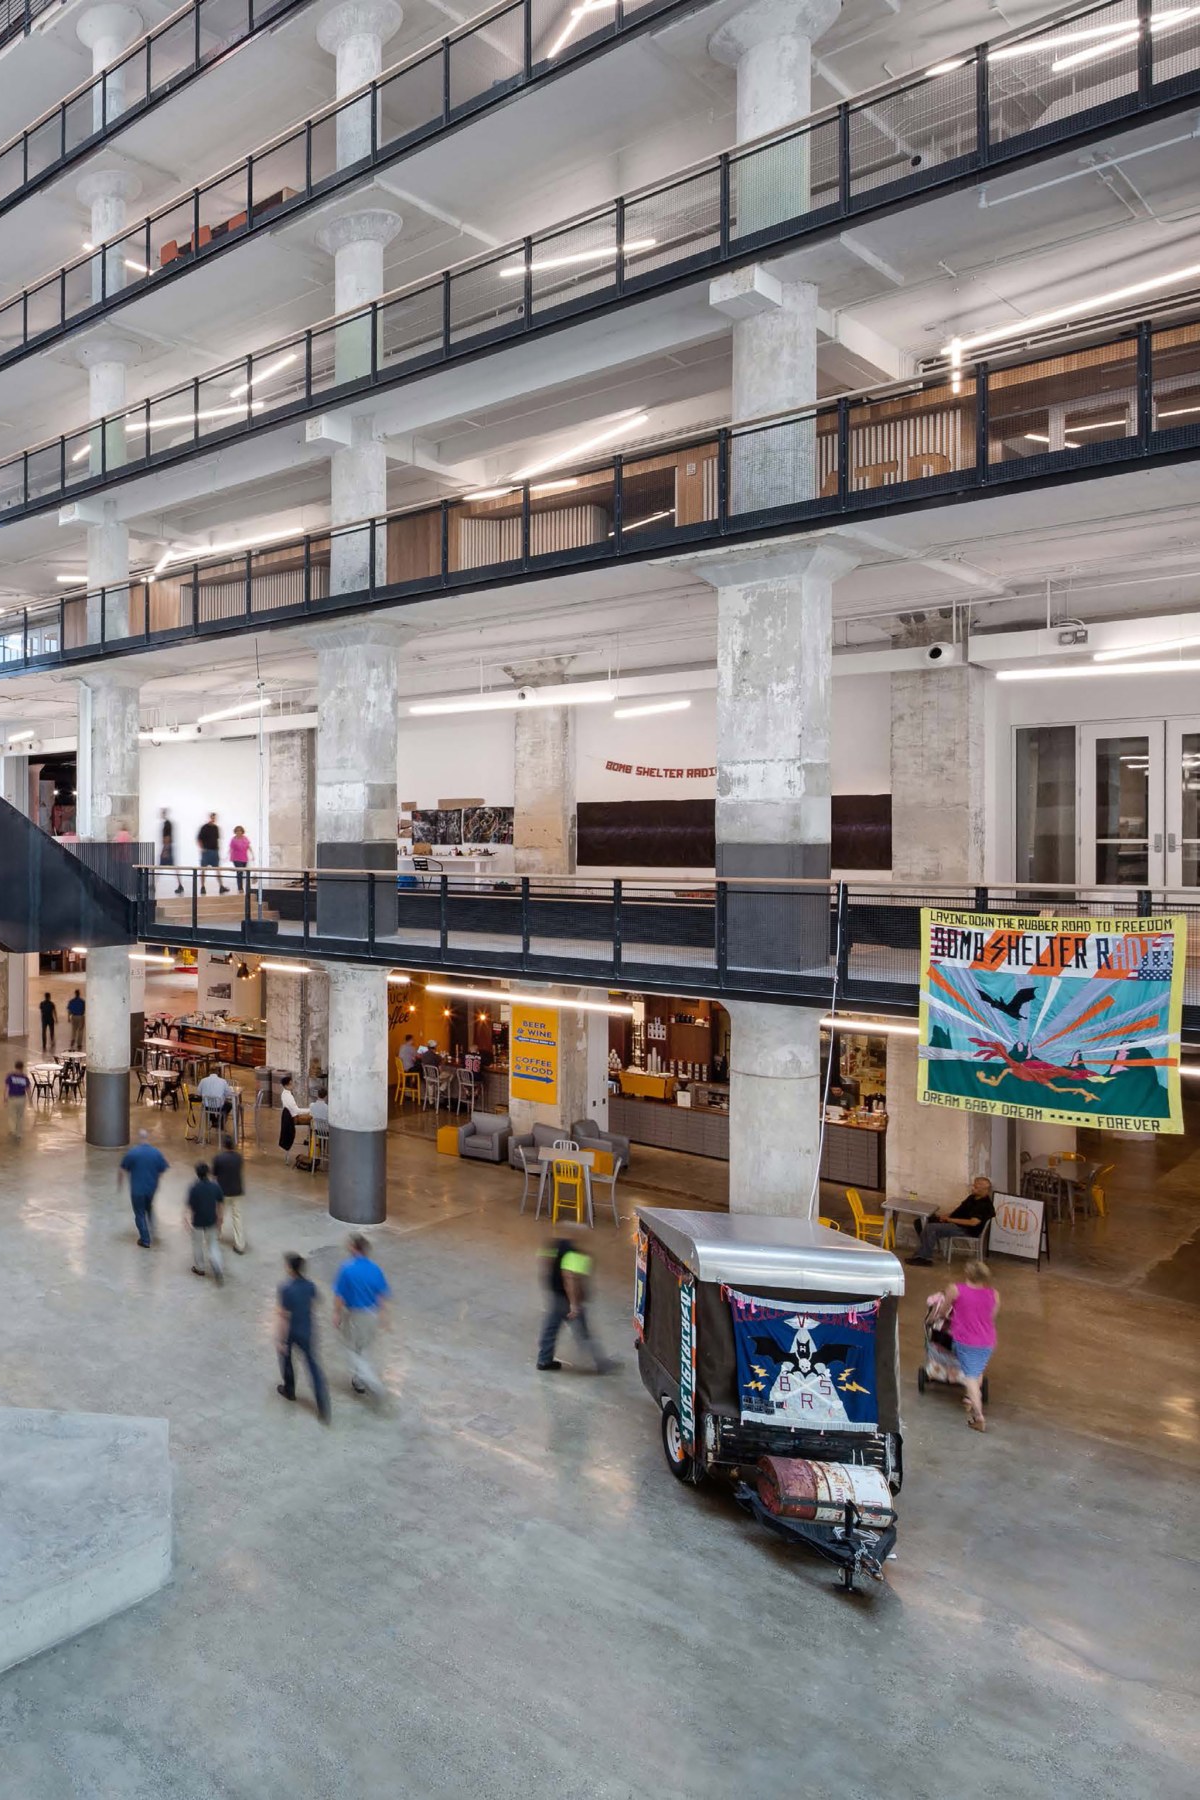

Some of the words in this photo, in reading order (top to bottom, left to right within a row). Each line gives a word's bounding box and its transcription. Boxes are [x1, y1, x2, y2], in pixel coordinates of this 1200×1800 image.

[605, 760, 633, 774] BOMB
[635, 766, 684, 778] SHELTER
[686, 766, 717, 778] RADI
[930, 911, 969, 926] LAYING
[969, 914, 995, 928] DOWN
[996, 917, 1016, 929] THE
[1017, 919, 1059, 932] RUBBER
[1061, 920, 1092, 932] ROAD
[1096, 920, 1111, 932] TO
[1115, 918, 1173, 933] FREEDOM
[933, 926, 985, 963] BOMB
[522, 1020, 546, 1029] BEER
[527, 1029, 552, 1039] WINE
[515, 1056, 552, 1068] COFFEE
[525, 1065, 554, 1076] FOOD
[923, 1090, 960, 1109] DREAM
[965, 1098, 998, 1114] BABY
[1001, 1103, 1043, 1120] DREAM
[1097, 1116, 1161, 1132] FOREVER
[779, 1376, 791, 1392] B
[819, 1379, 831, 1395] S
[801, 1393, 813, 1409] R
